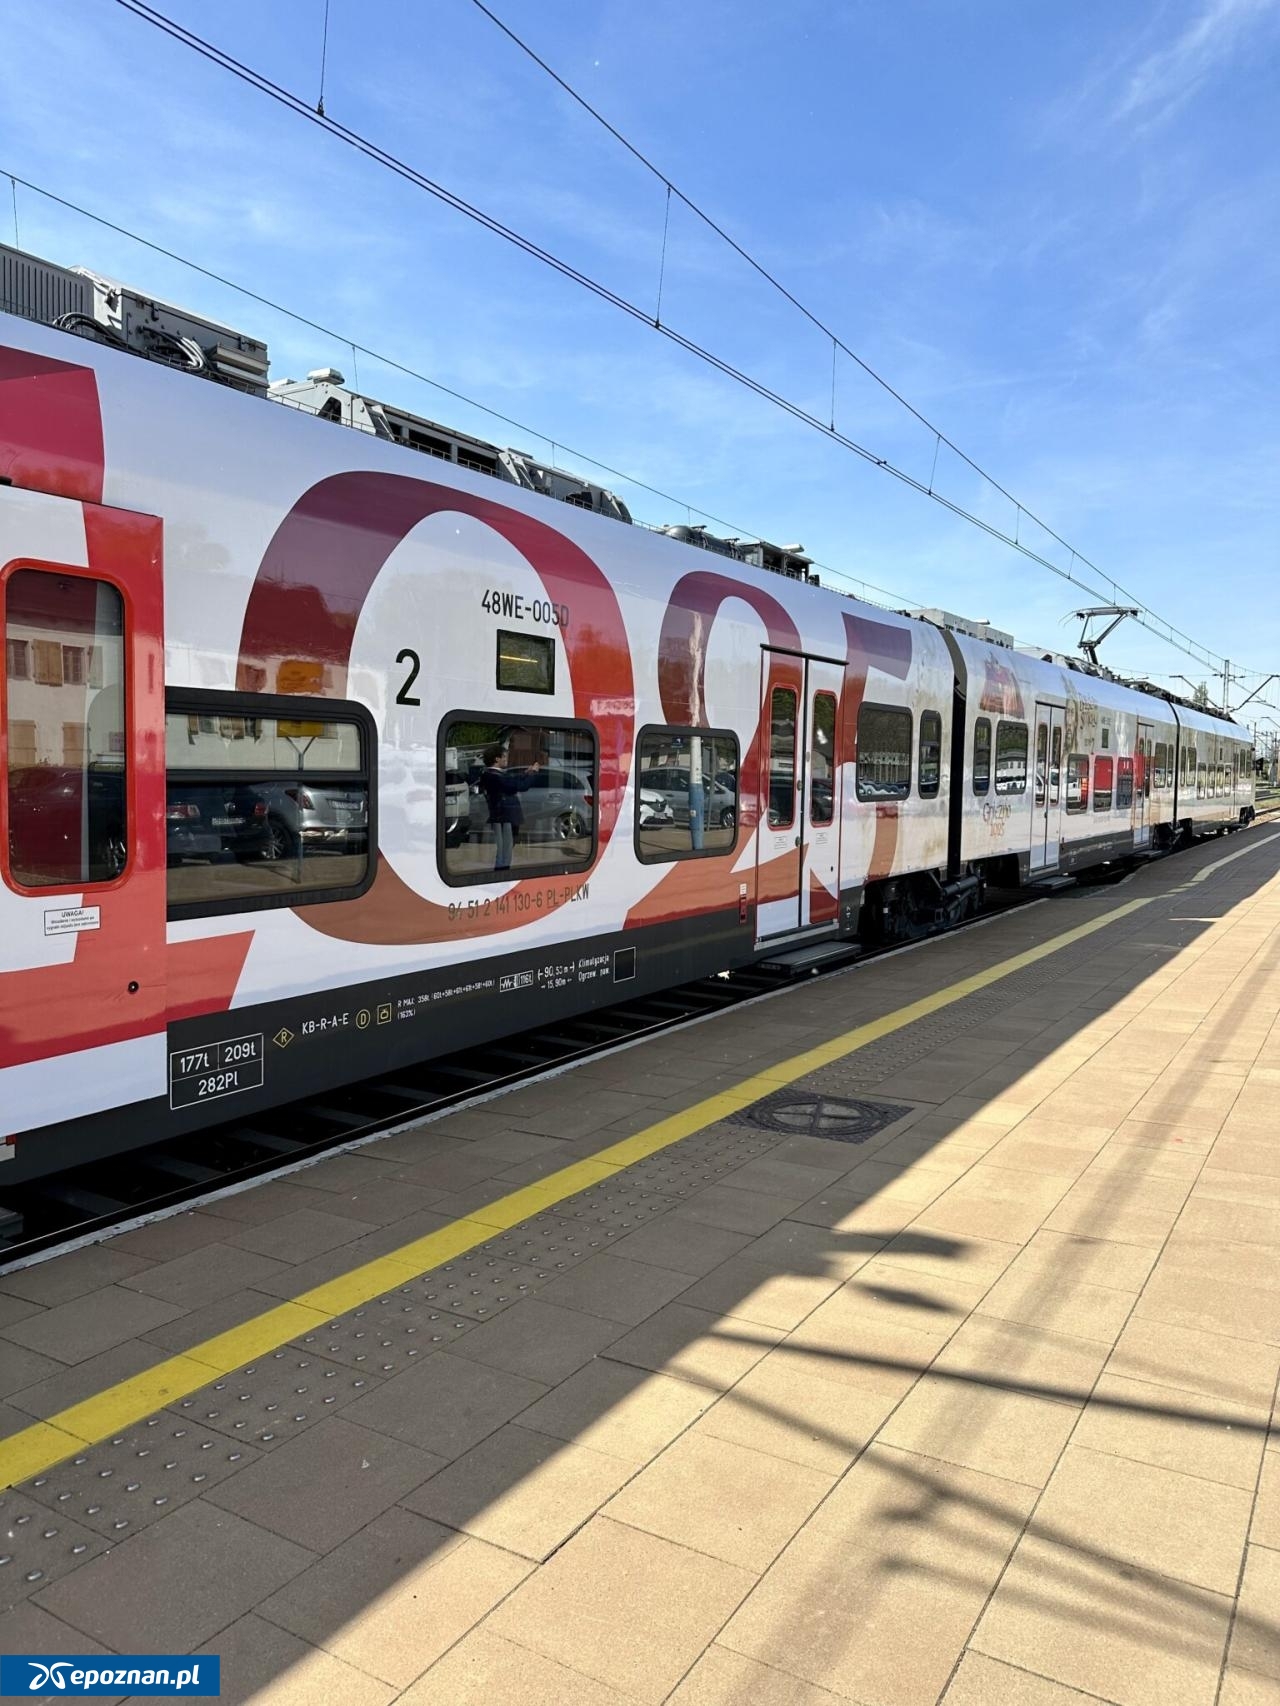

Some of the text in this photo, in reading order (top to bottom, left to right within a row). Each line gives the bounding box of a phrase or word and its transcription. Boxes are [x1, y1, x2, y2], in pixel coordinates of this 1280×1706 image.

[396, 648, 421, 706] 2
[467, 900, 479, 919] 51
[484, 898, 492, 916] 2
[495, 895, 510, 915] 141
[514, 892, 543, 912] 130-6
[546, 883, 590, 908] PL-PLKW
[302, 1013, 349, 1035] KB-R-A-E
[360, 1013, 367, 1026] D
[281, 1031, 288, 1043] R
[180, 1041, 257, 1073] 177t 209t
